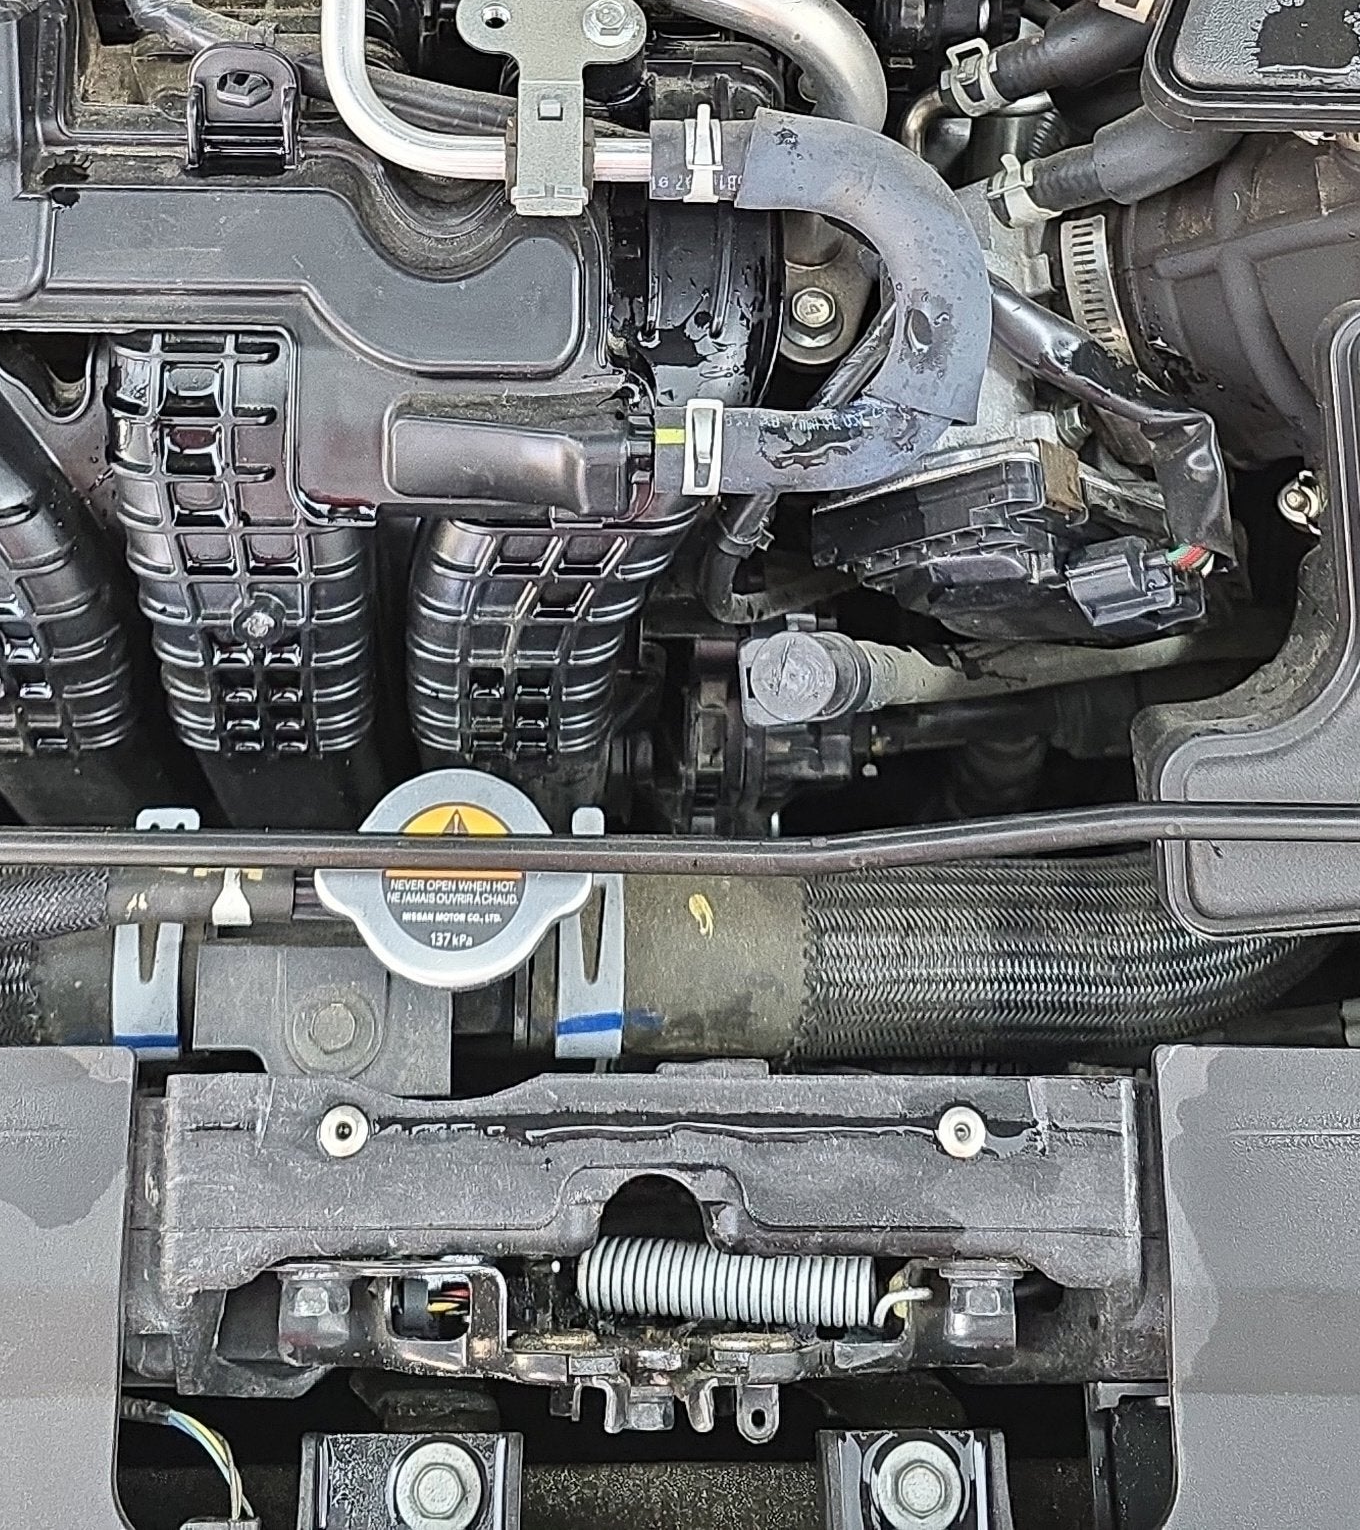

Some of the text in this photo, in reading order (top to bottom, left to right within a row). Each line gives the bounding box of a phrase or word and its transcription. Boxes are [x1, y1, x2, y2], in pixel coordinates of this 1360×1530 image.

[390, 879, 517, 892] NEVER OPEN WHEN HOT.
[387, 892, 400, 903] NE
[401, 892, 435, 904] JAMAIS
[436, 892, 474, 904] OUVRIR
[482, 892, 519, 905] CHAUD.
[402, 911, 434, 922] NISSAN
[435, 912, 466, 923] MOTOR
[431, 931, 473, 946] 137 kPa
